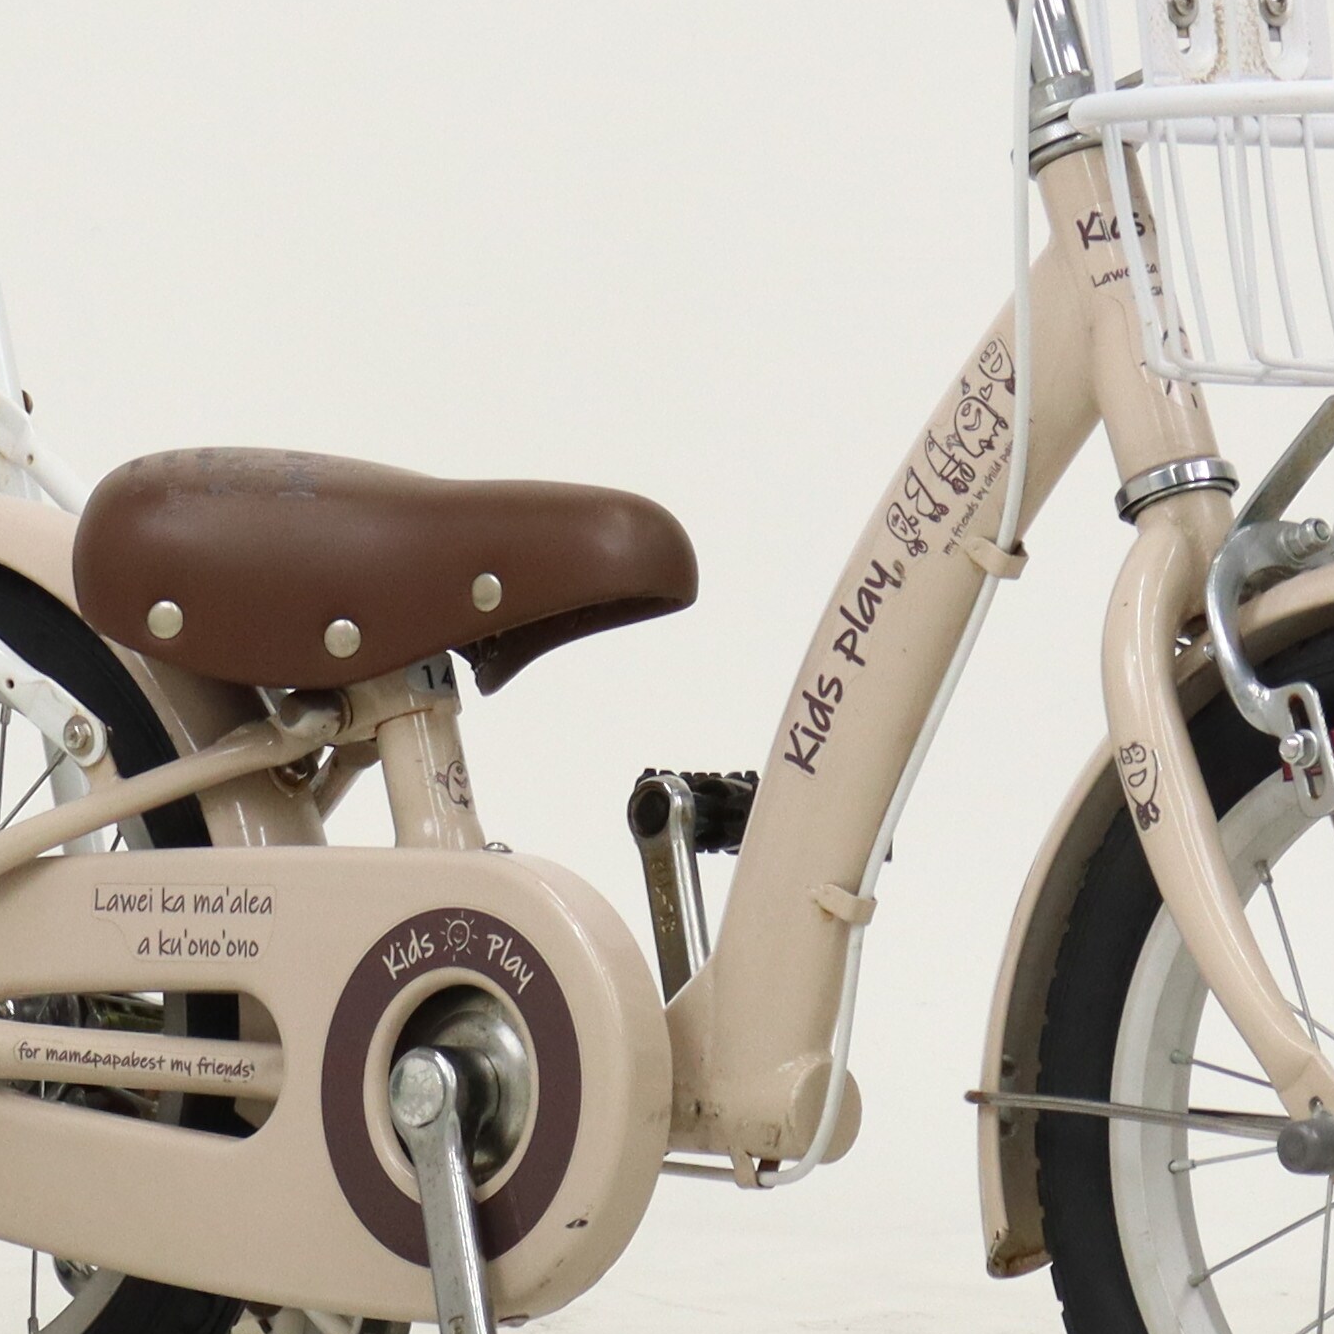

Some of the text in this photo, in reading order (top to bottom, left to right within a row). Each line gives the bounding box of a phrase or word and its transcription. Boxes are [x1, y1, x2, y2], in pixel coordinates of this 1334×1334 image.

[1091, 267, 1129, 288] Law
[943, 538, 960, 555] my
[952, 502, 978, 538] friends
[973, 488, 989, 500] by
[422, 664, 454, 690] 14
[784, 674, 843, 775] Kids
[94, 886, 273, 915] Lawei ka ma'alea
[137, 928, 259, 958] a ku'ono'ono
[382, 928, 534, 995] Kids Play
[18, 1041, 40, 1060] for
[46, 1046, 166, 1071] mam&papabest
[171, 1059, 192, 1077] my
